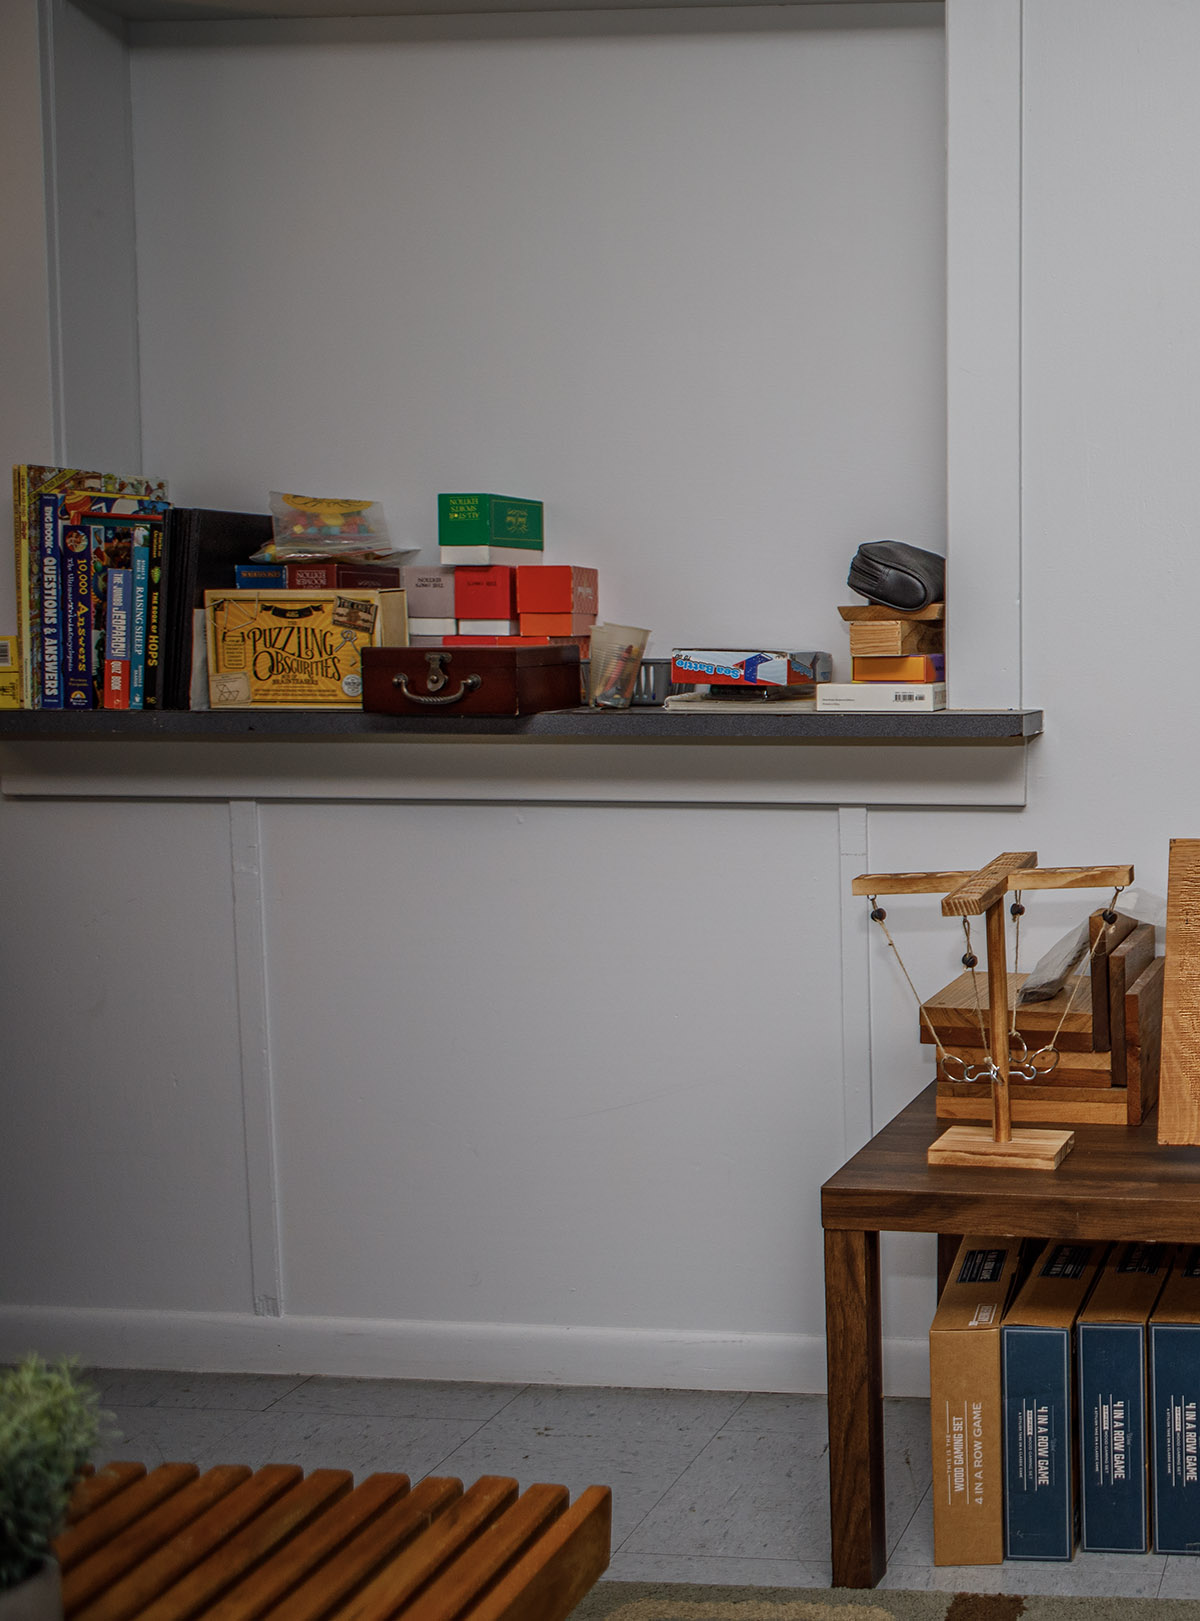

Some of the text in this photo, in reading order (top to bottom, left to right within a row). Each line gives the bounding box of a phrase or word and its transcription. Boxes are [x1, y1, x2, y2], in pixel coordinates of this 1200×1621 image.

[44, 506, 53, 523] BIG
[44, 524, 53, 548] BOOK
[77, 559, 88, 595] 10,000
[43, 557, 57, 624] QUESTIONS
[44, 627, 56, 635] &
[110, 573, 126, 691] THE JUMBO JEOPARDY! QUIZ BOOK
[135, 586, 144, 655] RAISING SHEEP
[151, 625, 158, 633] OF
[147, 635, 159, 667] HOPS
[247, 626, 334, 659] PUZZLING
[44, 638, 58, 695] ANSWERS
[254, 651, 341, 681] OBSCURITIES
[675, 660, 740, 679] Sea Battle
[972, 1402, 982, 1437] GAME
[1037, 1415, 1048, 1424] IN
[1113, 1410, 1124, 1418] IN
[1186, 1411, 1196, 1420] IN
[1038, 1436, 1049, 1457] ROW
[1114, 1430, 1125, 1451] ROW
[1186, 1432, 1197, 1453] ROW
[953, 1416, 964, 1492] WOOD GAMING SET
[973, 1440, 982, 1467] ROW
[974, 1471, 983, 1479] A
[1038, 1459, 1049, 1486] GAME
[1114, 1454, 1125, 1479] GAME
[1186, 1456, 1197, 1481] GAME
[974, 1482, 984, 1494] IN
